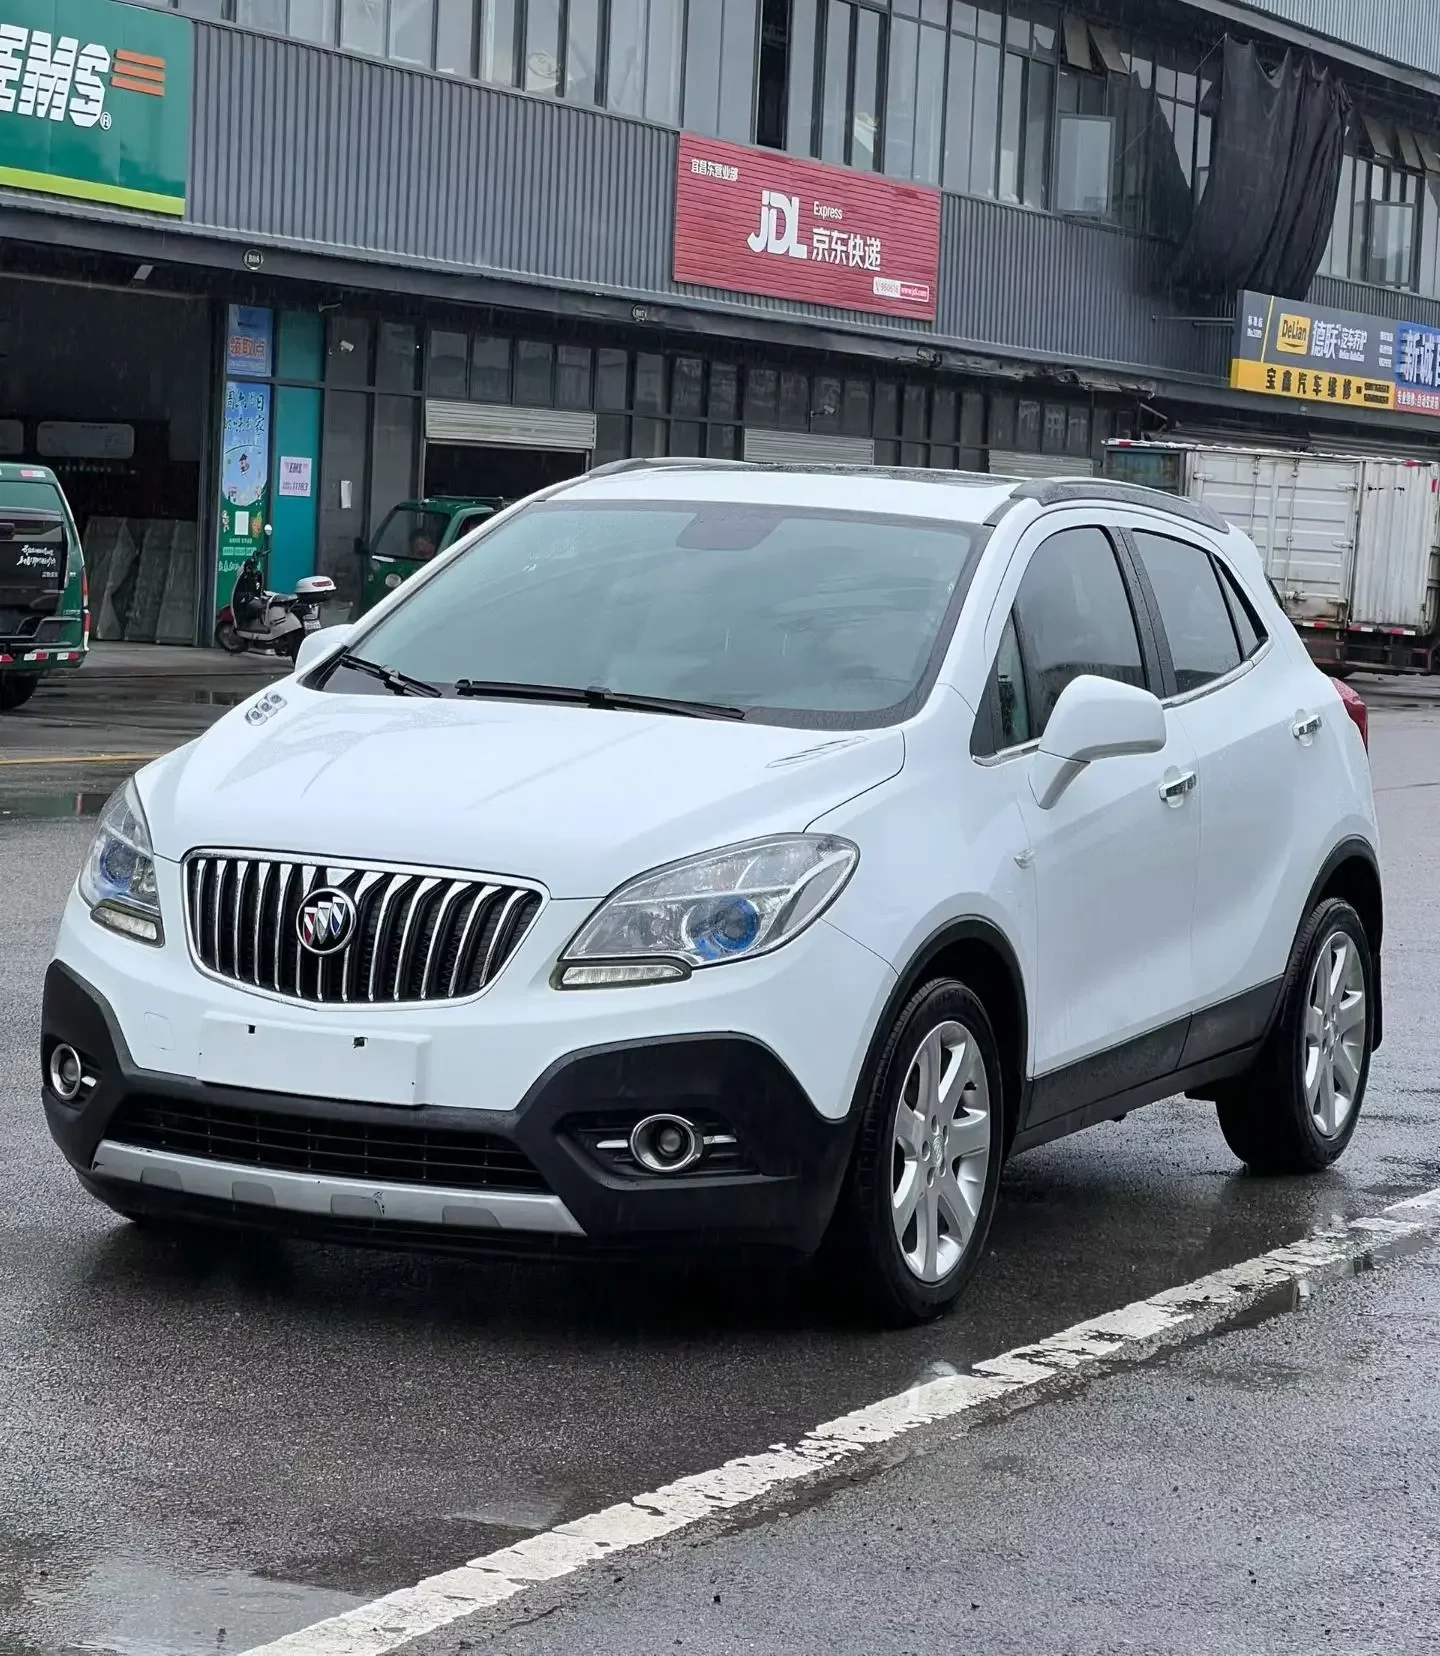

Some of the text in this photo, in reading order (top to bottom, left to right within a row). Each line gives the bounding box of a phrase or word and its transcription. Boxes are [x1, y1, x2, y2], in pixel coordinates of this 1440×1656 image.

[0, 24, 110, 127] EMS
[690, 158, 739, 182] 宜昌东营业部
[813, 200, 843, 220] Express
[747, 190, 807, 259] JDL
[812, 227, 881, 271] 京东快递
[1281, 319, 1307, 342] DeLian
[289, 462, 303, 474] EMS
